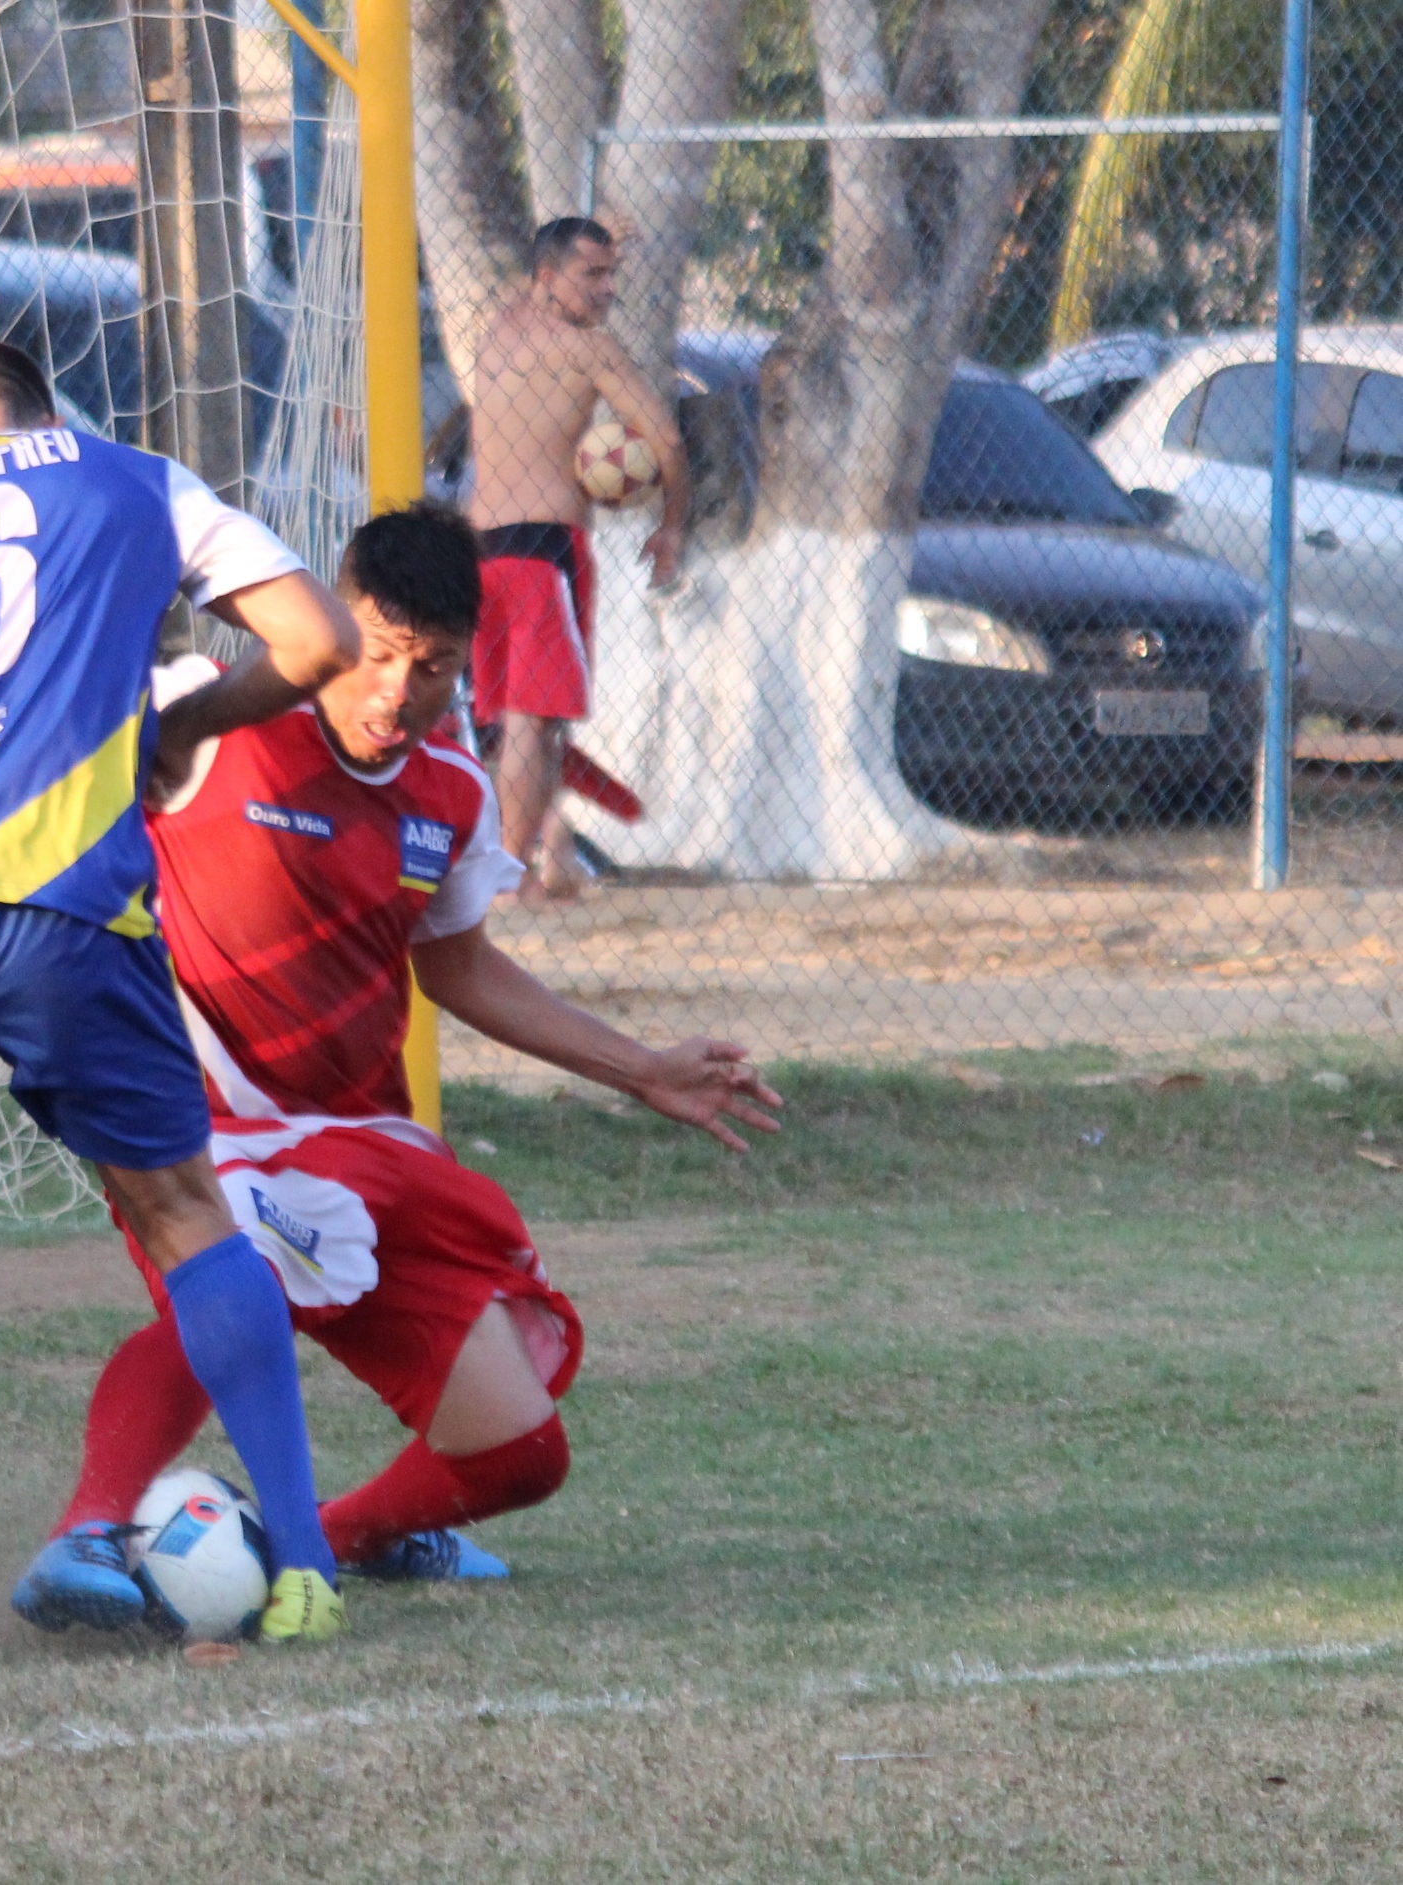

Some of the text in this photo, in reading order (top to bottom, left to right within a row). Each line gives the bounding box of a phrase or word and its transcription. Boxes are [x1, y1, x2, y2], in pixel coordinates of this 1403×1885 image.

[247, 801, 331, 837] Ouro Vida
[405, 820, 454, 854] AABB
